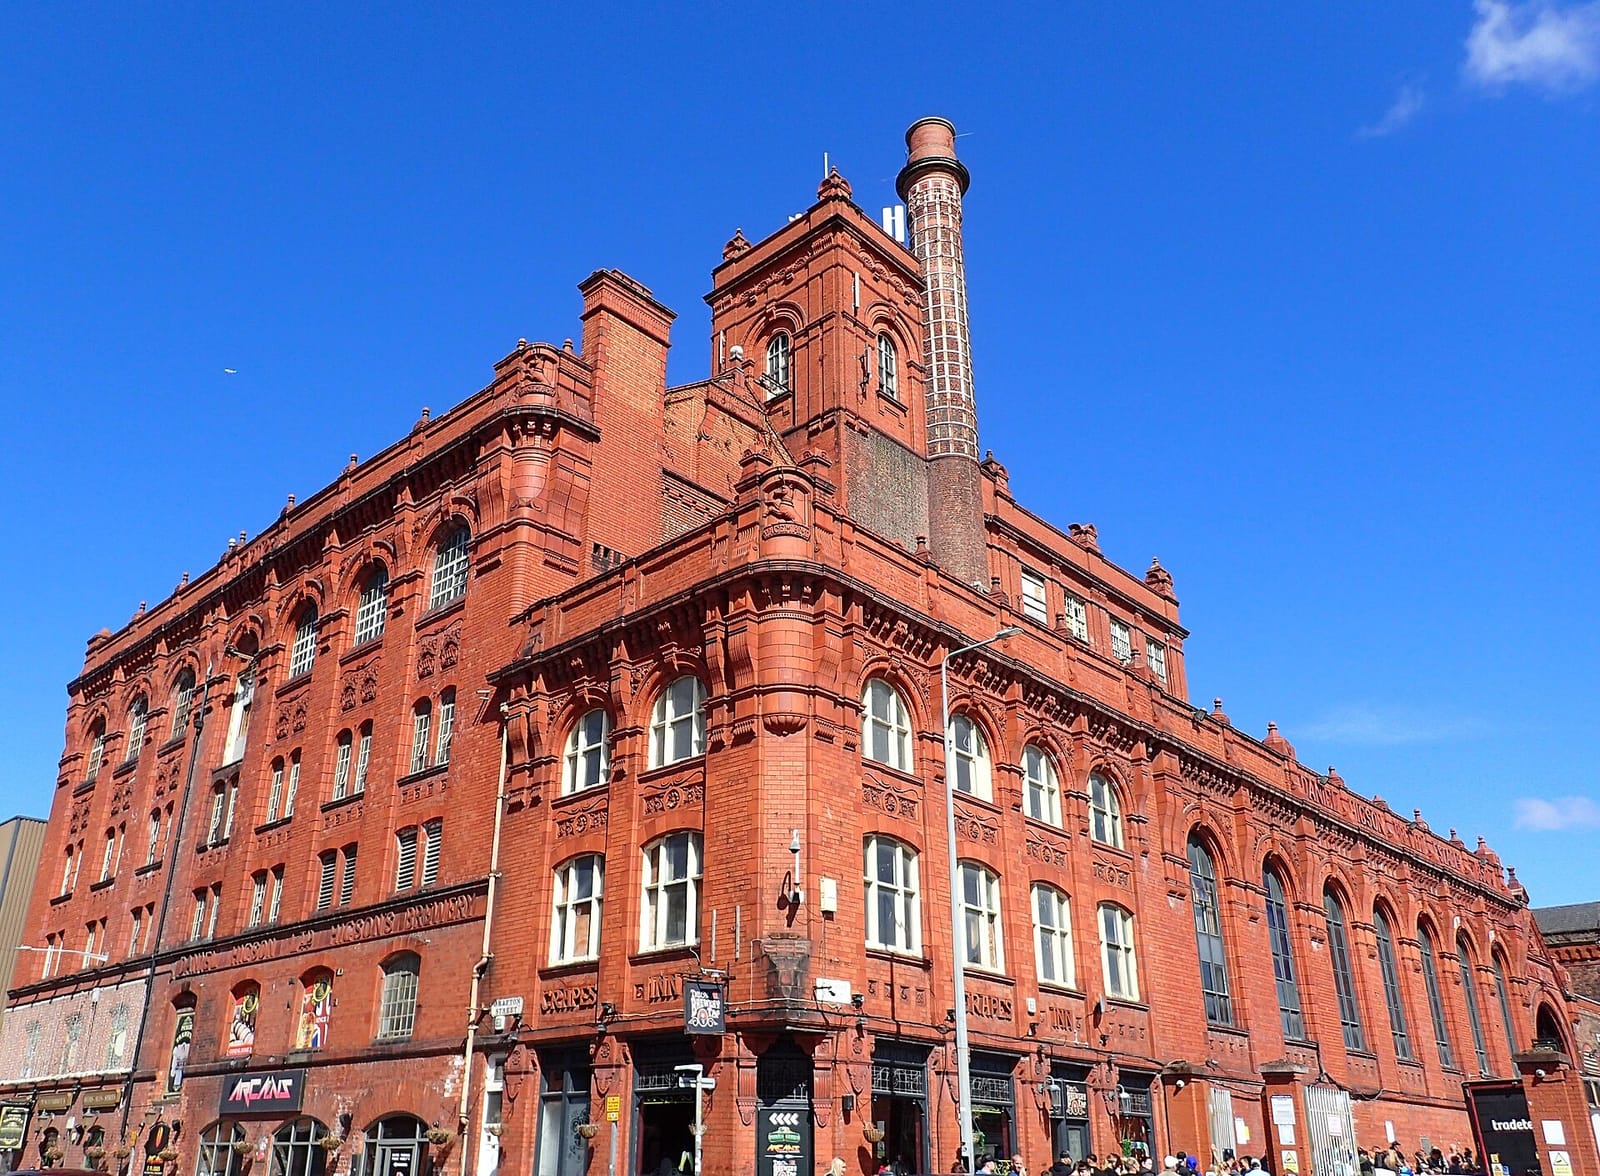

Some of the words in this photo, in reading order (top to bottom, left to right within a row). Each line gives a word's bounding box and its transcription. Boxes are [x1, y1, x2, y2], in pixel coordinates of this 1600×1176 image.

[403, 893, 476, 931] BREWERY
[647, 974, 681, 1002] INN
[496, 1006, 518, 1016] STREET
[1050, 1006, 1074, 1030] INN
